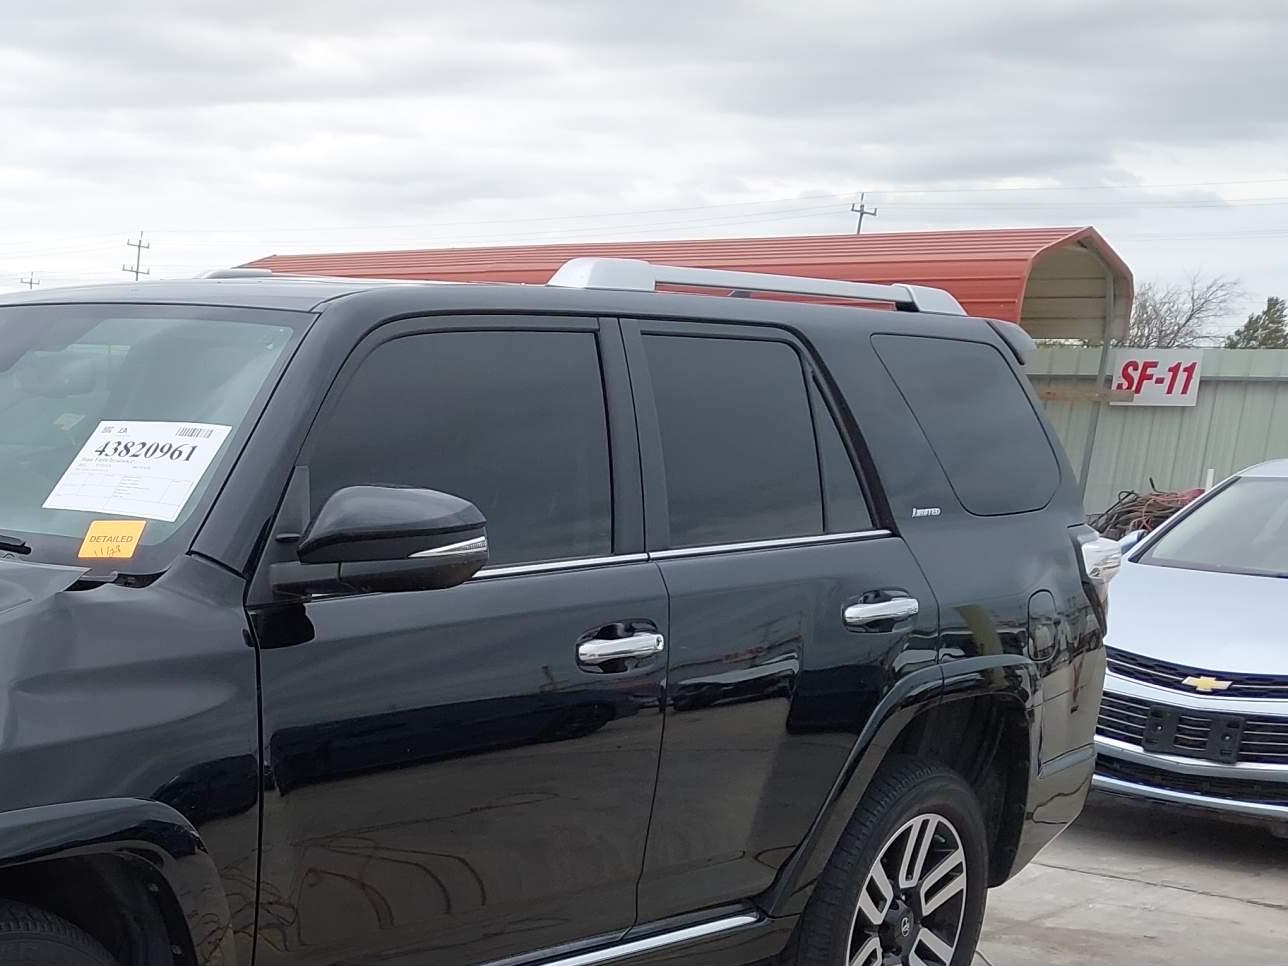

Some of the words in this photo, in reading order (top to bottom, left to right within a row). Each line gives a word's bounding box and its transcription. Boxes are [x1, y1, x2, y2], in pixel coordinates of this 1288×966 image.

[1116, 360, 1198, 394] SF-11
[95, 440, 198, 461] 43820961
[88, 535, 134, 543] DETAILED
